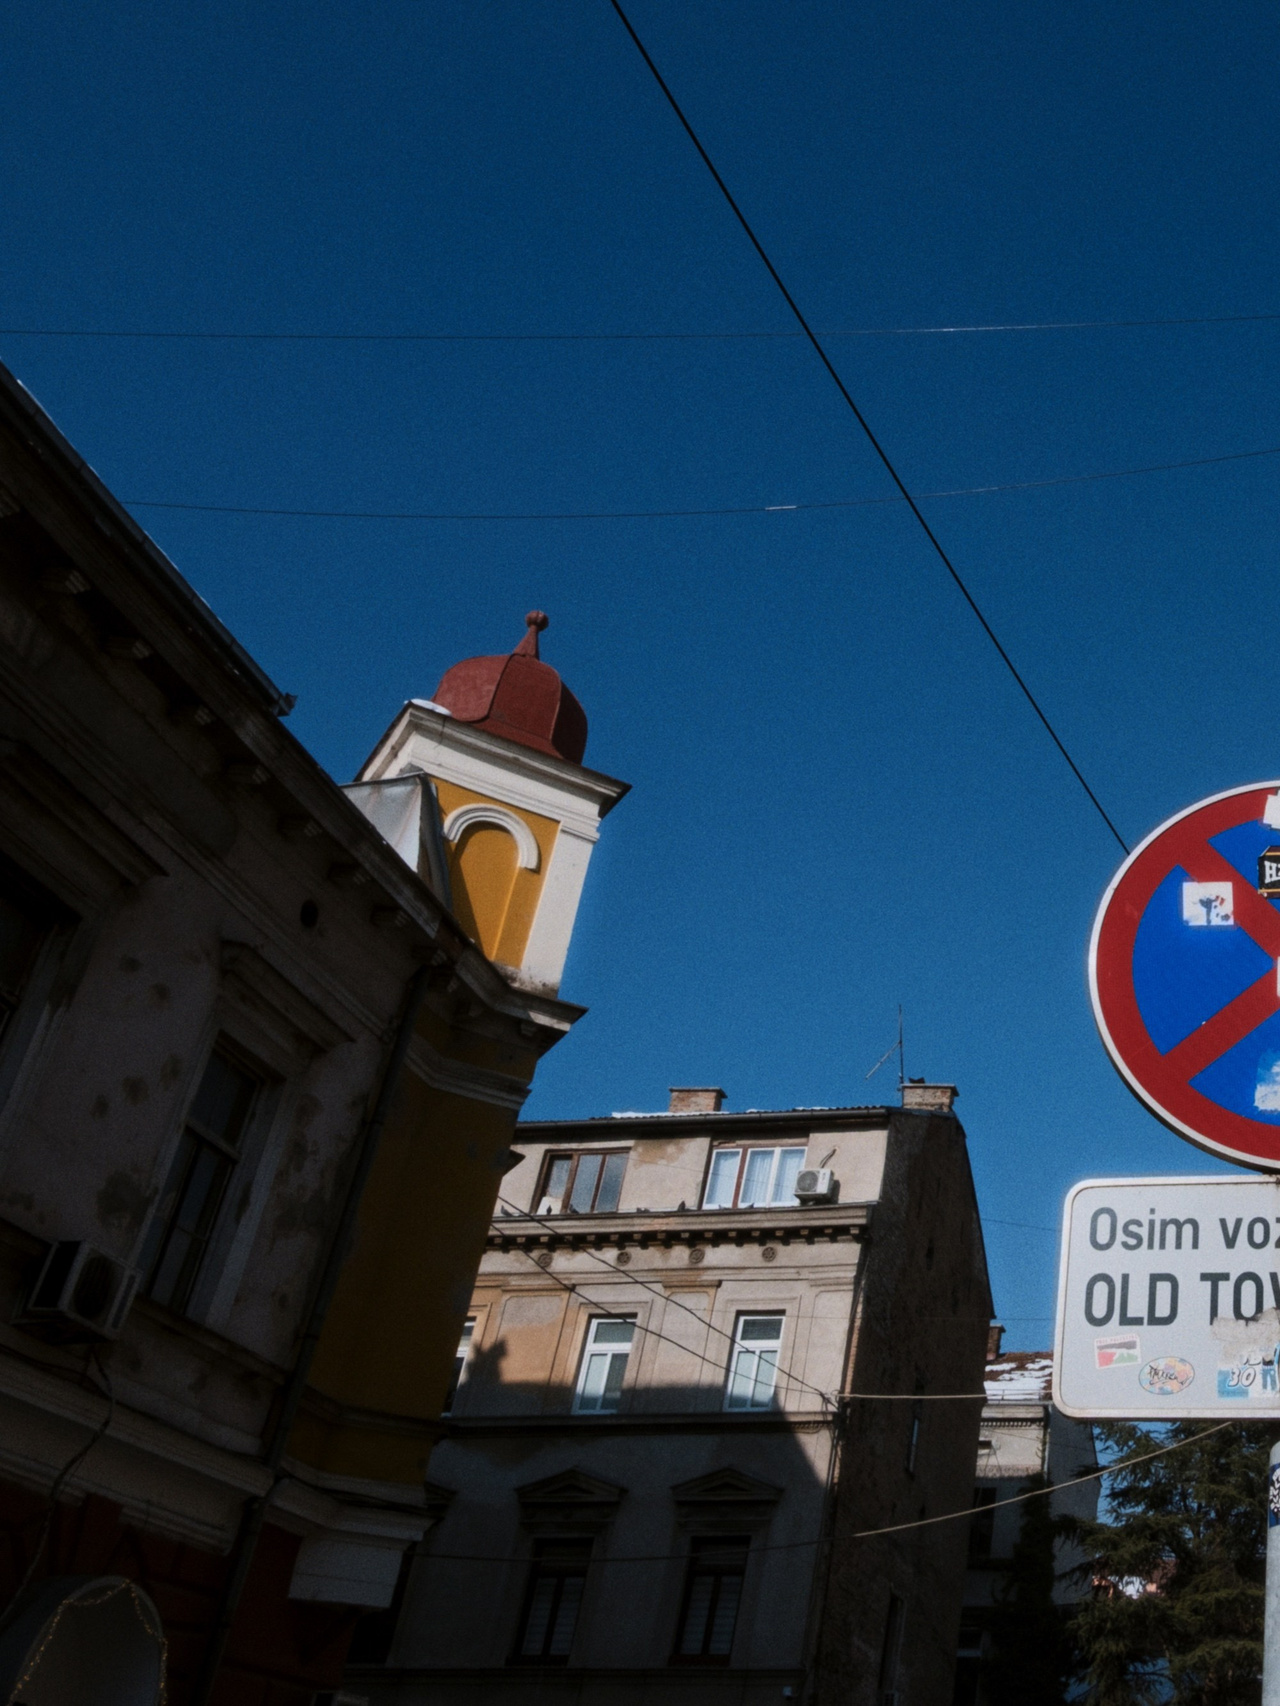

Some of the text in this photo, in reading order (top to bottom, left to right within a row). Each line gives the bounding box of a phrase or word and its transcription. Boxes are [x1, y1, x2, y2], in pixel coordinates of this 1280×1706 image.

[1089, 1207, 1200, 1251] Osim
[1084, 1273, 1179, 1327] OLD
[1227, 1367, 1257, 1388] 30
